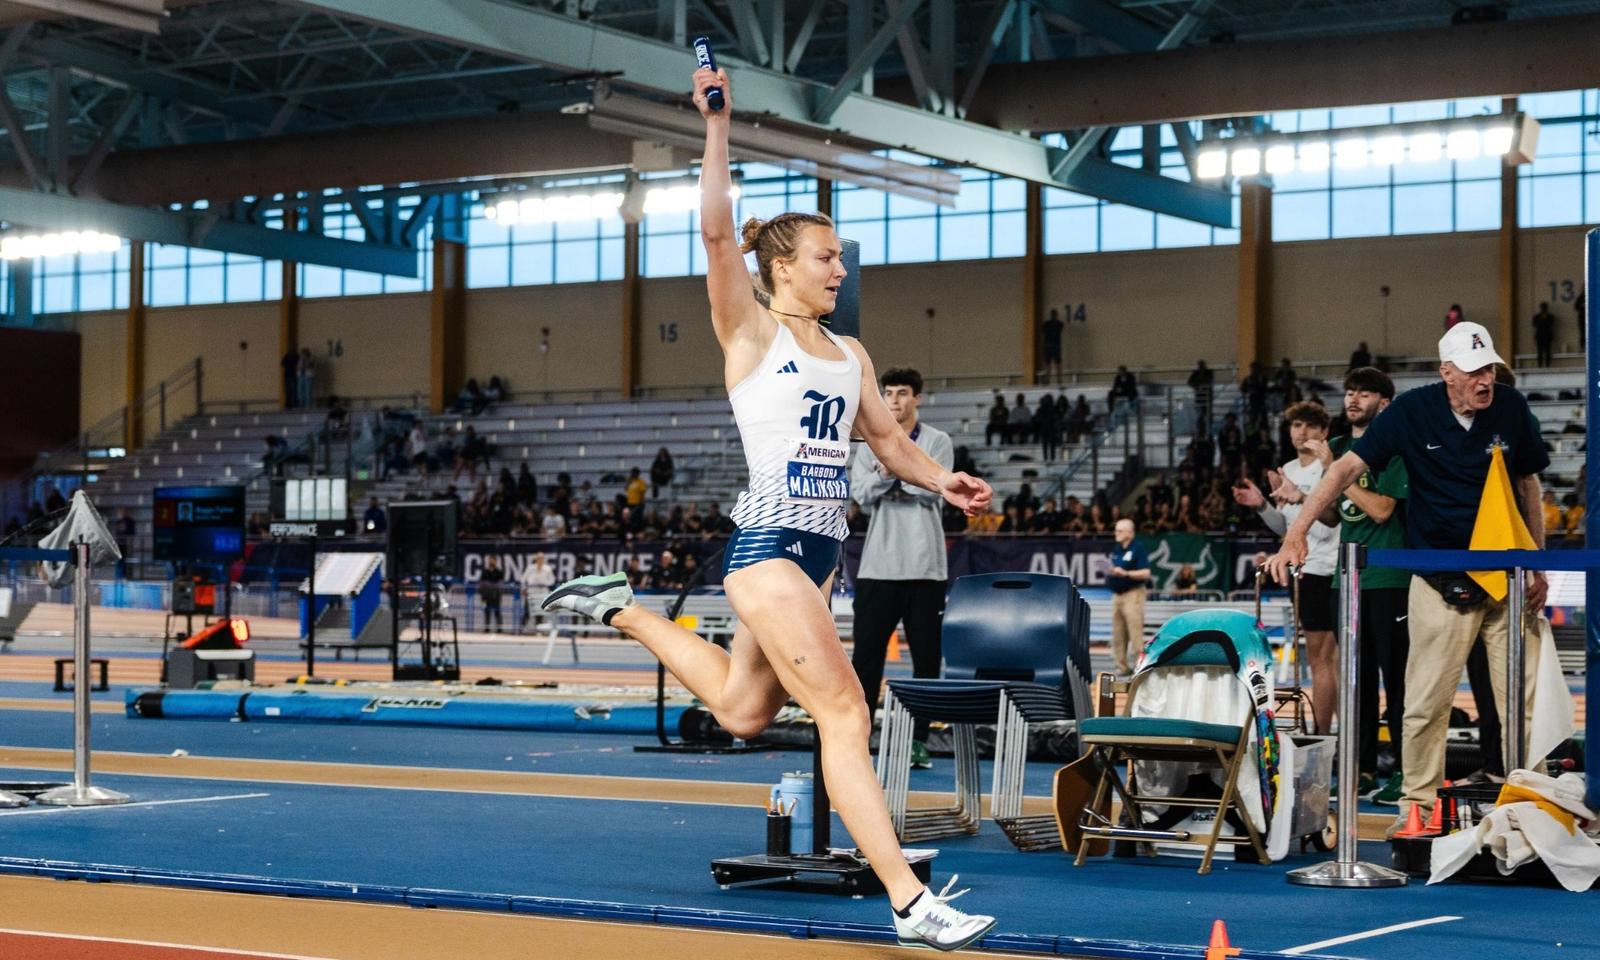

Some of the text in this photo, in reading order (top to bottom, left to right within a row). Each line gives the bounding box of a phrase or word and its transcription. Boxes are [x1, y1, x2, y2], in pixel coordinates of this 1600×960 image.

[695, 44, 711, 67] RICE
[1549, 280, 1575, 303] 13
[1064, 303, 1086, 323] 14
[659, 322, 678, 343] 15
[1472, 333, 1485, 350] A
[327, 338, 345, 358] 16
[800, 389, 846, 441] R
[796, 443, 846, 459] AMERICAN
[789, 475, 848, 499] MALIKOVA
[1029, 552, 1109, 585] AME
